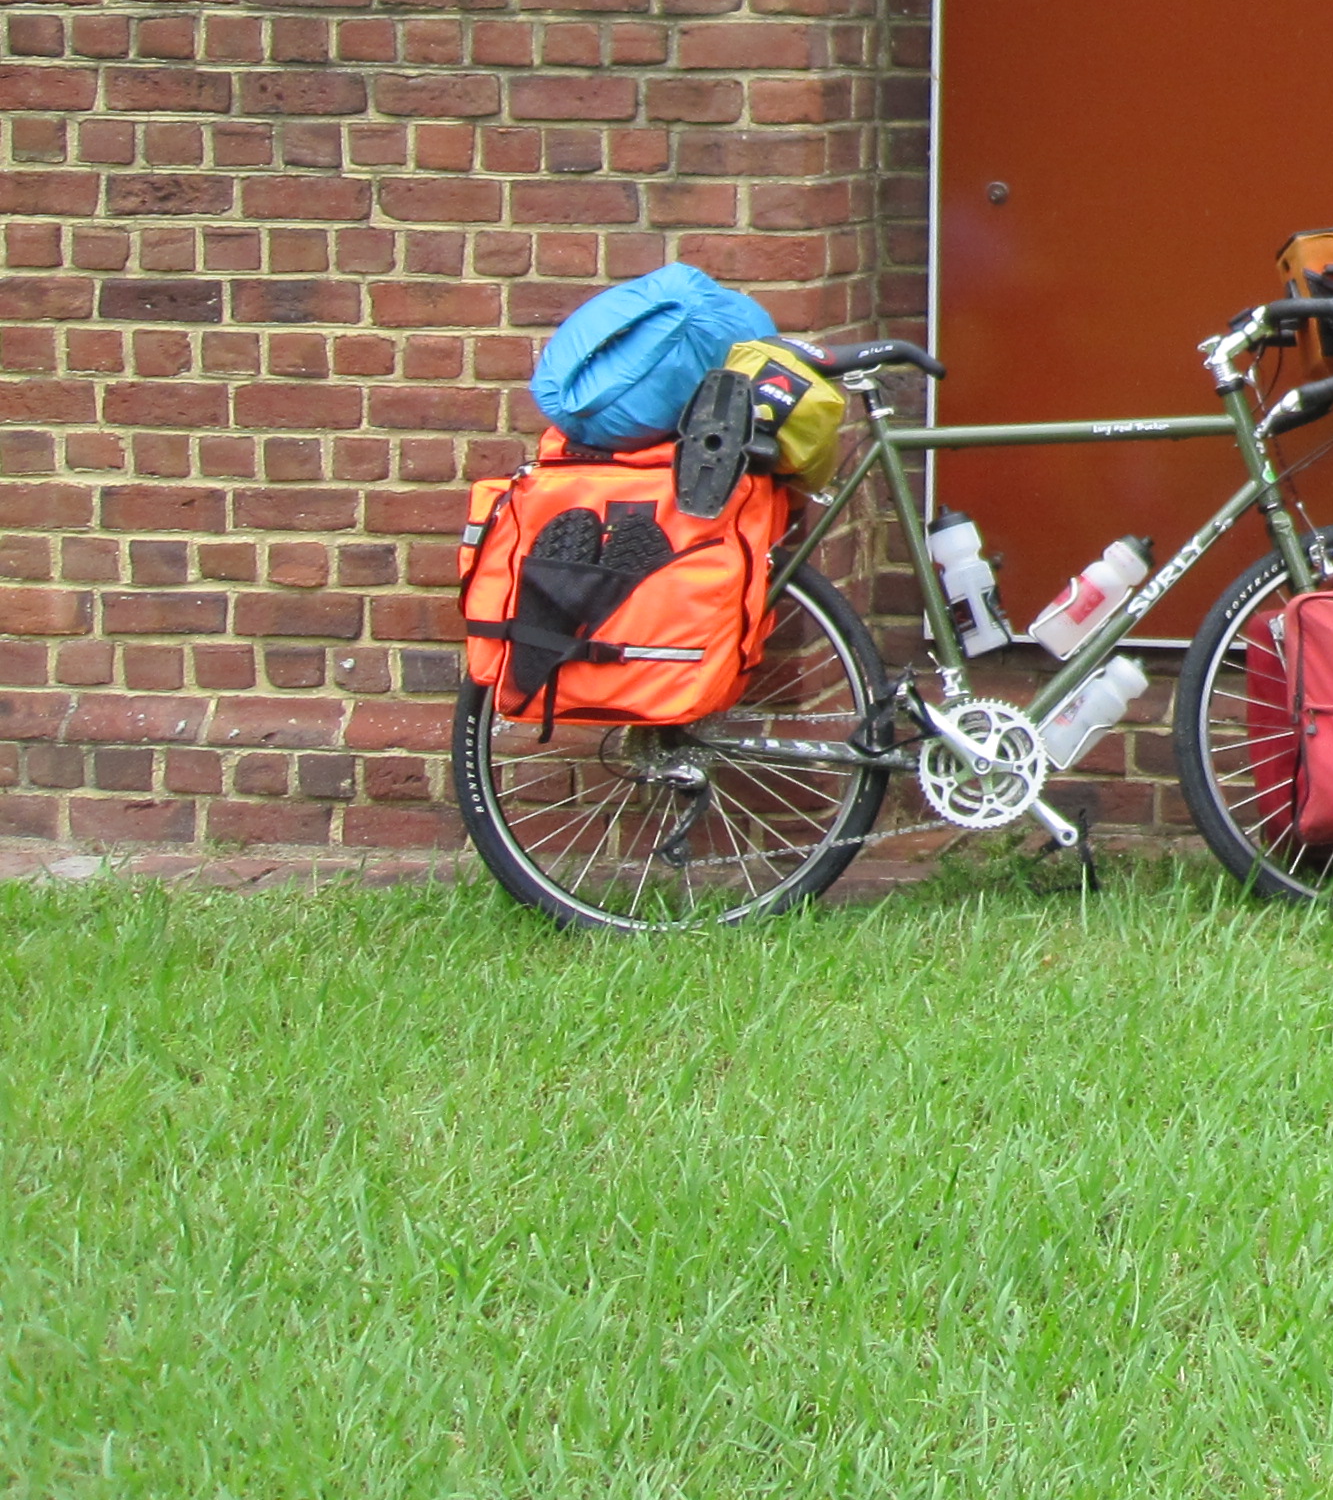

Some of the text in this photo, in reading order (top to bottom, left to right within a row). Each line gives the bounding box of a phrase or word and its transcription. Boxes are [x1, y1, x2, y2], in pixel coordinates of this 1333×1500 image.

[759, 383, 797, 406] MSR
[1126, 534, 1203, 620] SURLY
[1224, 558, 1287, 620] BONTRAG
[464, 714, 486, 813] BONTRAGER
